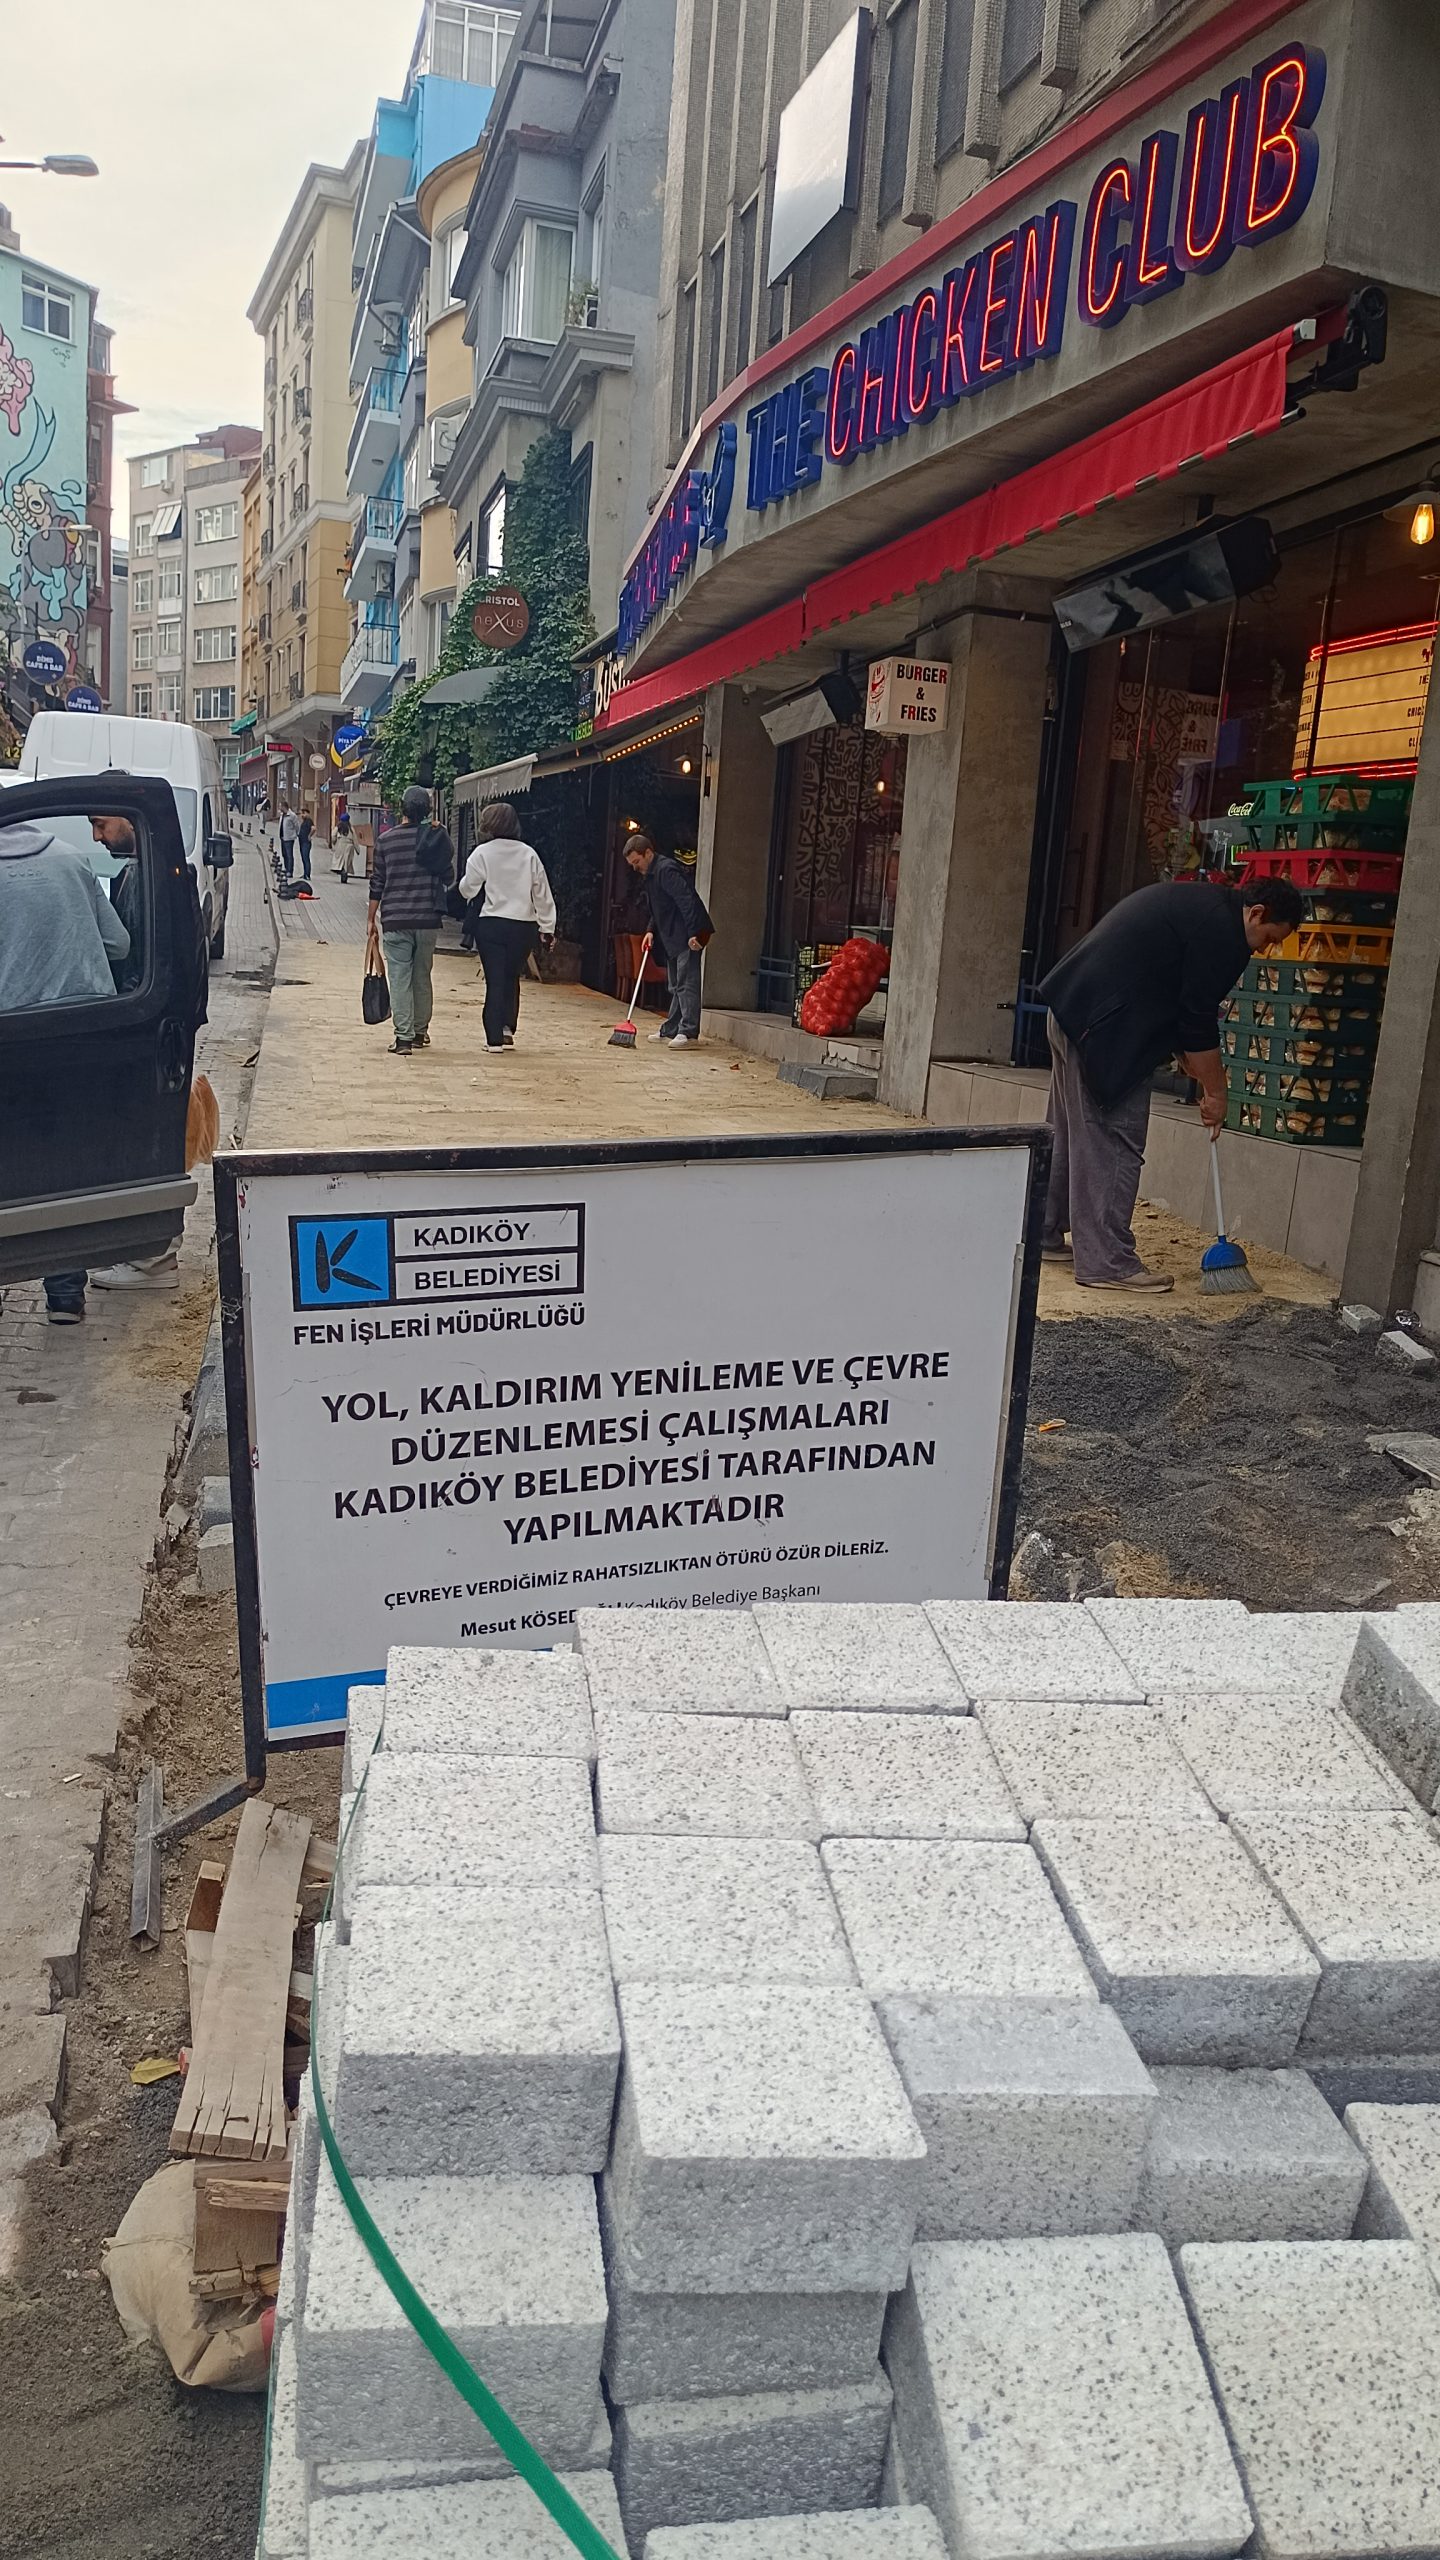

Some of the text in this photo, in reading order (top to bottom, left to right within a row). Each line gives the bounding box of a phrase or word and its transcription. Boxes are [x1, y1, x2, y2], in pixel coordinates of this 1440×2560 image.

[747, 41, 1327, 511] THE CHICKEN CLUB
[479, 595, 520, 607] RISTOL
[896, 663, 948, 684] BURGER
[916, 687, 925, 700] &
[900, 704, 937, 722] FRIES
[414, 1219, 531, 1247] KADIKÖY
[414, 1259, 560, 1290] BELEDİYESİ
[294, 1302, 585, 1345] FEN İŞLERİ MÜDÜRLÜĞÜ
[321, 1351, 950, 1422] YOL, KALDIRIM YENİLEME VE ÇEVRE
[392, 1399, 889, 1466] DÜZENLEMESİ ÇALIŞMALARI
[334, 1440, 936, 1519] KADIKÖY BELEDİYESİ TARAFINDAN
[503, 1493, 784, 1545] YAPILMAKTADIR
[383, 1541, 889, 1610] ÇEVREYE VERDİĞİMİZ RAHATSIZLIKTAN ÖTÜRÜ ÖZÜR DİLERİZ.
[460, 1618, 517, 1637] Mesut
[691, 1589, 758, 1607] Belediye
[761, 1583, 821, 1601] Başkanı
